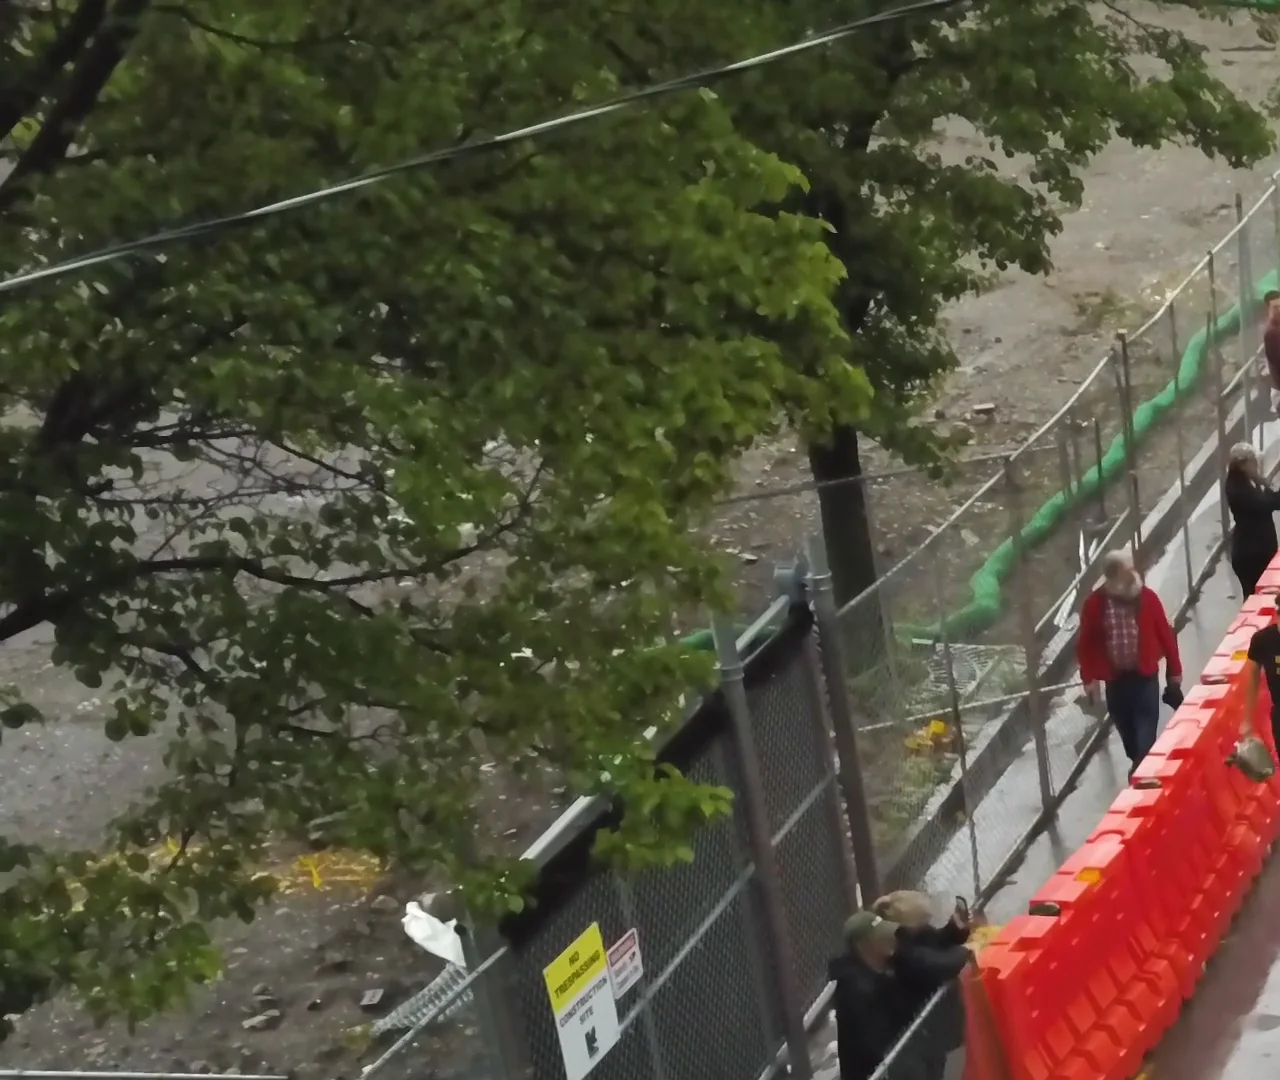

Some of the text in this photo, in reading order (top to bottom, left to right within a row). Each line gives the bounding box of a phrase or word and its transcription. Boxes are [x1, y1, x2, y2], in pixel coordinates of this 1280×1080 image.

[554, 949, 601, 999] TRESPASSING
[569, 950, 580, 967] NO
[560, 976, 607, 1028] CONSTRUCTION
[579, 1005, 594, 1025] SITE
